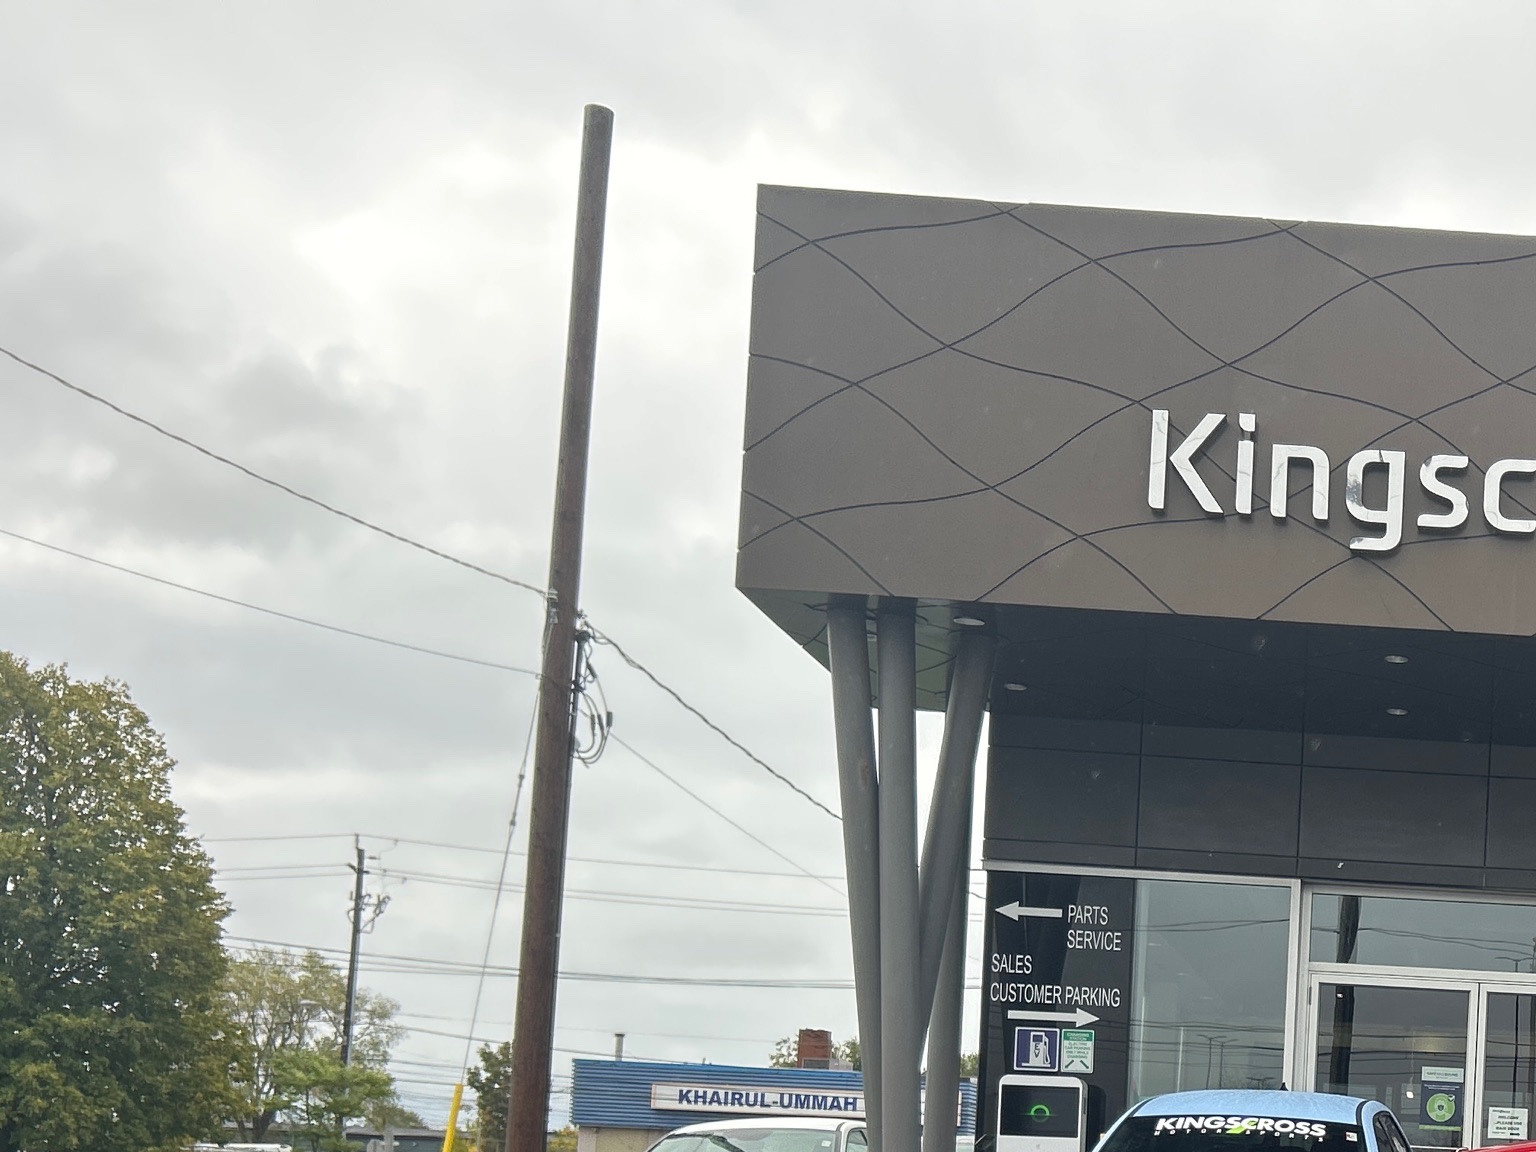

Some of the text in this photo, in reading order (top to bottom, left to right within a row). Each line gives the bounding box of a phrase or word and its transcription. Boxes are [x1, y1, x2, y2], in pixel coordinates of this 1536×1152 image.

[1067, 904, 1109, 925] PARTS
[1066, 929, 1122, 951] SERVICE
[991, 953, 1033, 974] SALES
[990, 982, 1121, 1008] CUSTOMER PARKING
[678, 1089, 858, 1112] KHAIRUL-UMMAH
[1156, 1116, 1326, 1137] KINGSCROSS
